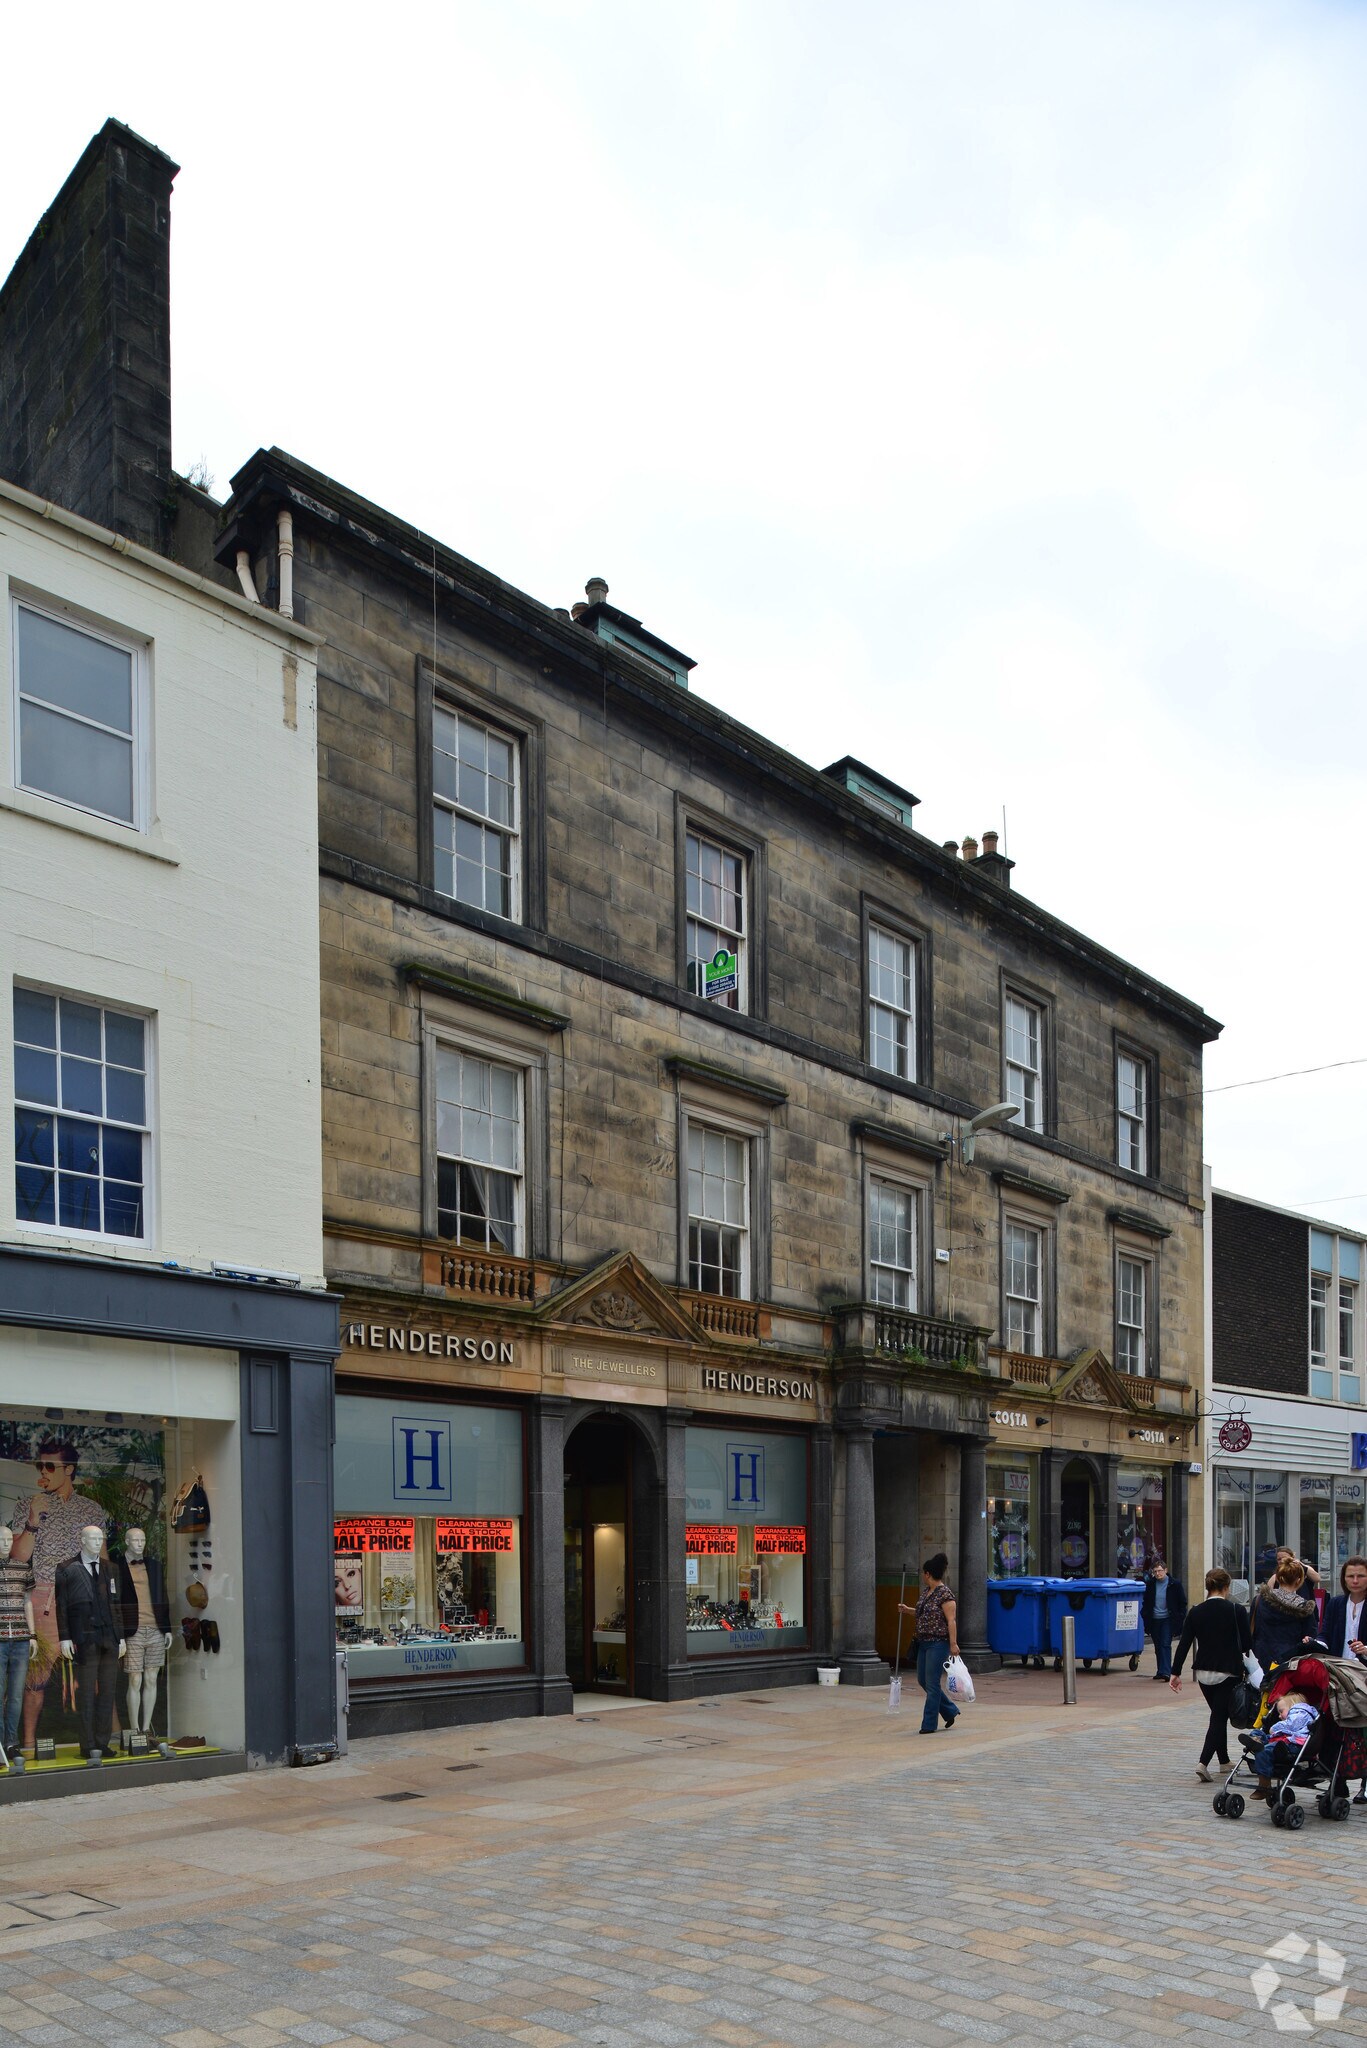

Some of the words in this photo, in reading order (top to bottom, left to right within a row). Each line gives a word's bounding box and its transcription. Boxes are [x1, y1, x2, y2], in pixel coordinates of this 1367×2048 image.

[350, 1323, 514, 1364] HENDERSON
[572, 1357, 593, 1369] THE
[596, 1360, 656, 1376] JEWELLERS
[705, 1369, 813, 1399] HENDERSON
[995, 1410, 1028, 1427] COSTA
[1225, 1422, 1244, 1432] COSTA
[1140, 1430, 1164, 1444] COSTA
[1222, 1438, 1247, 1450] COFFEE
[400, 1428, 445, 1490] H
[731, 1452, 760, 1502] H
[368, 1535, 411, 1550] PRICE
[438, 1535, 470, 1550] HALF
[472, 1536, 511, 1550] PRICE
[708, 1540, 735, 1553] PRICE
[756, 1540, 777, 1552] HALF
[779, 1540, 804, 1552] PRICE
[729, 1630, 765, 1643] HENDERSON
[404, 1648, 457, 1663] HENDERSON
[425, 1663, 452, 1671] Jewellers
